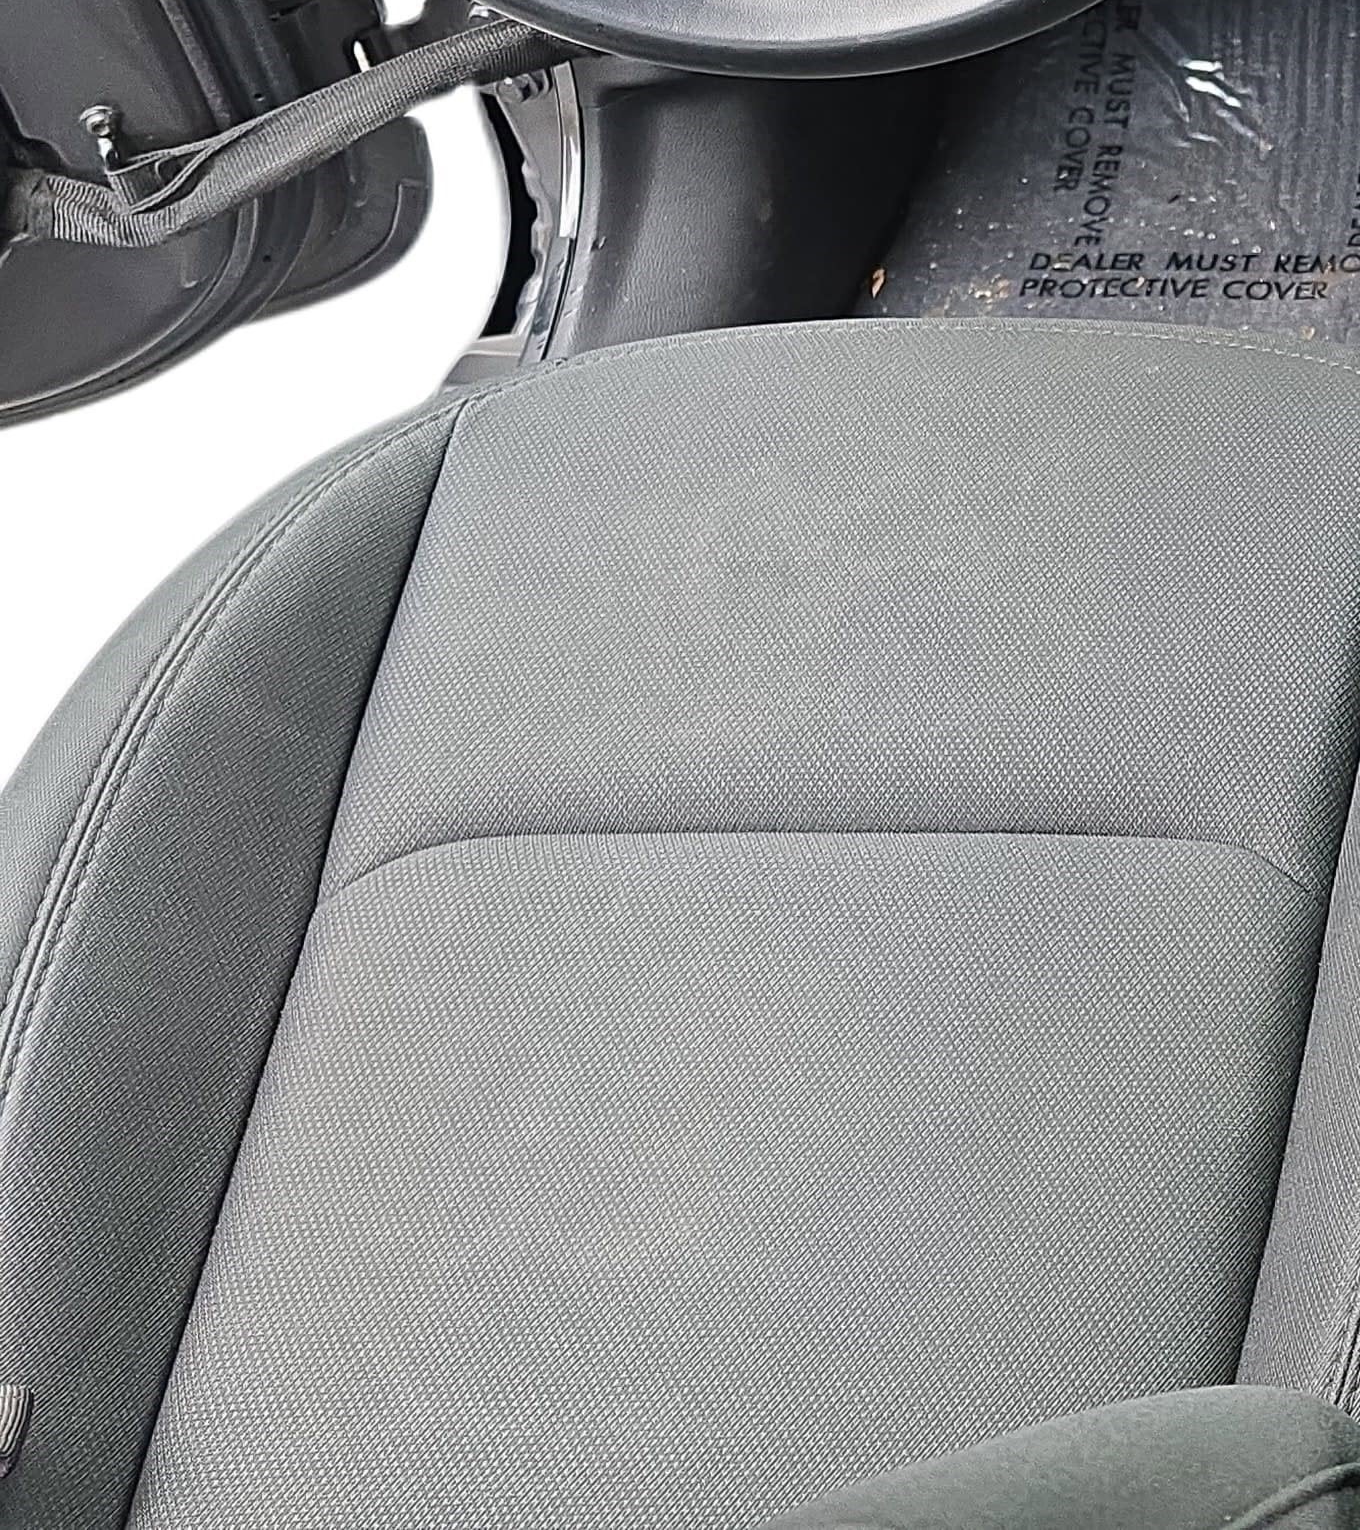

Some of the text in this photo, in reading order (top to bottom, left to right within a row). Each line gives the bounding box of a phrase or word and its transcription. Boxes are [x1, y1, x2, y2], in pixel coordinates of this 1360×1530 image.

[1053, 106, 1096, 194] COVER
[1074, 51, 1137, 248] MUST REMOVE
[1018, 276, 1329, 302] PROTECTIVE COVER
[1028, 251, 1145, 272] DEALER
[1164, 252, 1258, 273] MUST
